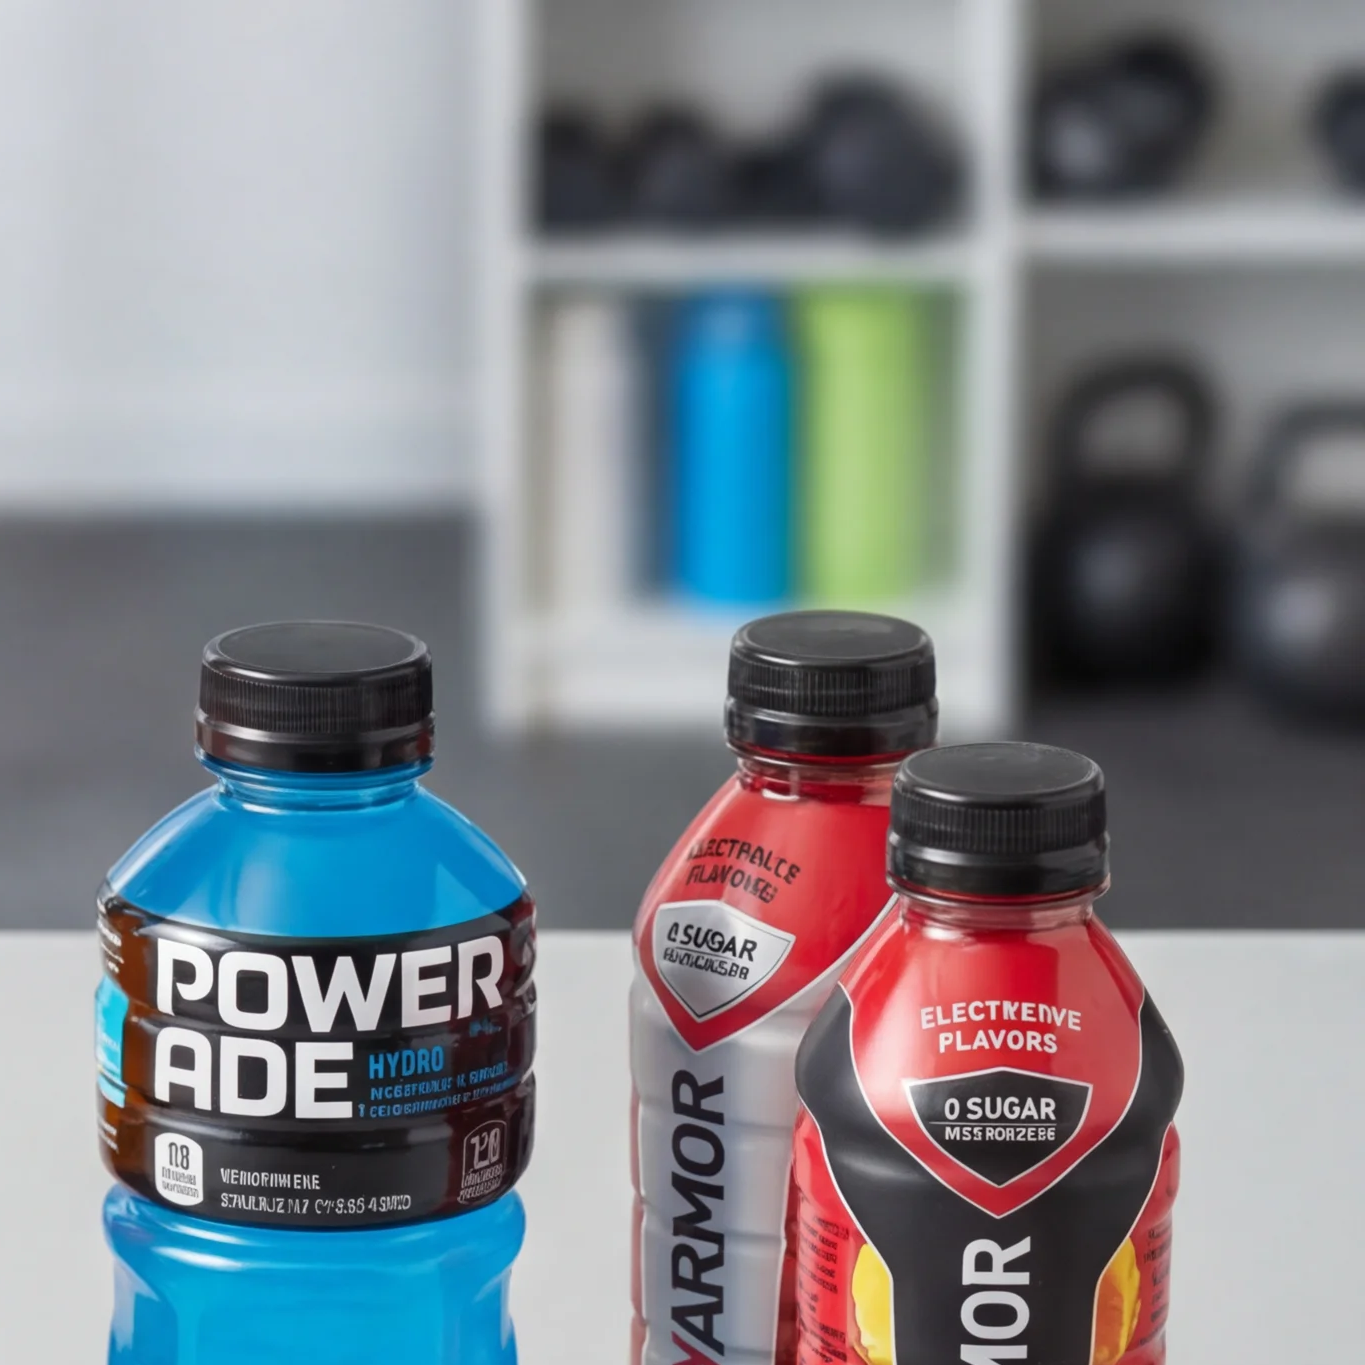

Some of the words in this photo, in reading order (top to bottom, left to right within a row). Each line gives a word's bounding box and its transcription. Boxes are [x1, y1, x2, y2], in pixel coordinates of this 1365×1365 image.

[156, 935, 505, 1033] POWER
[154, 1026, 354, 1119] ADE
[369, 1045, 445, 1079] HYDRO
[966, 1096, 1057, 1121] SUGAR
